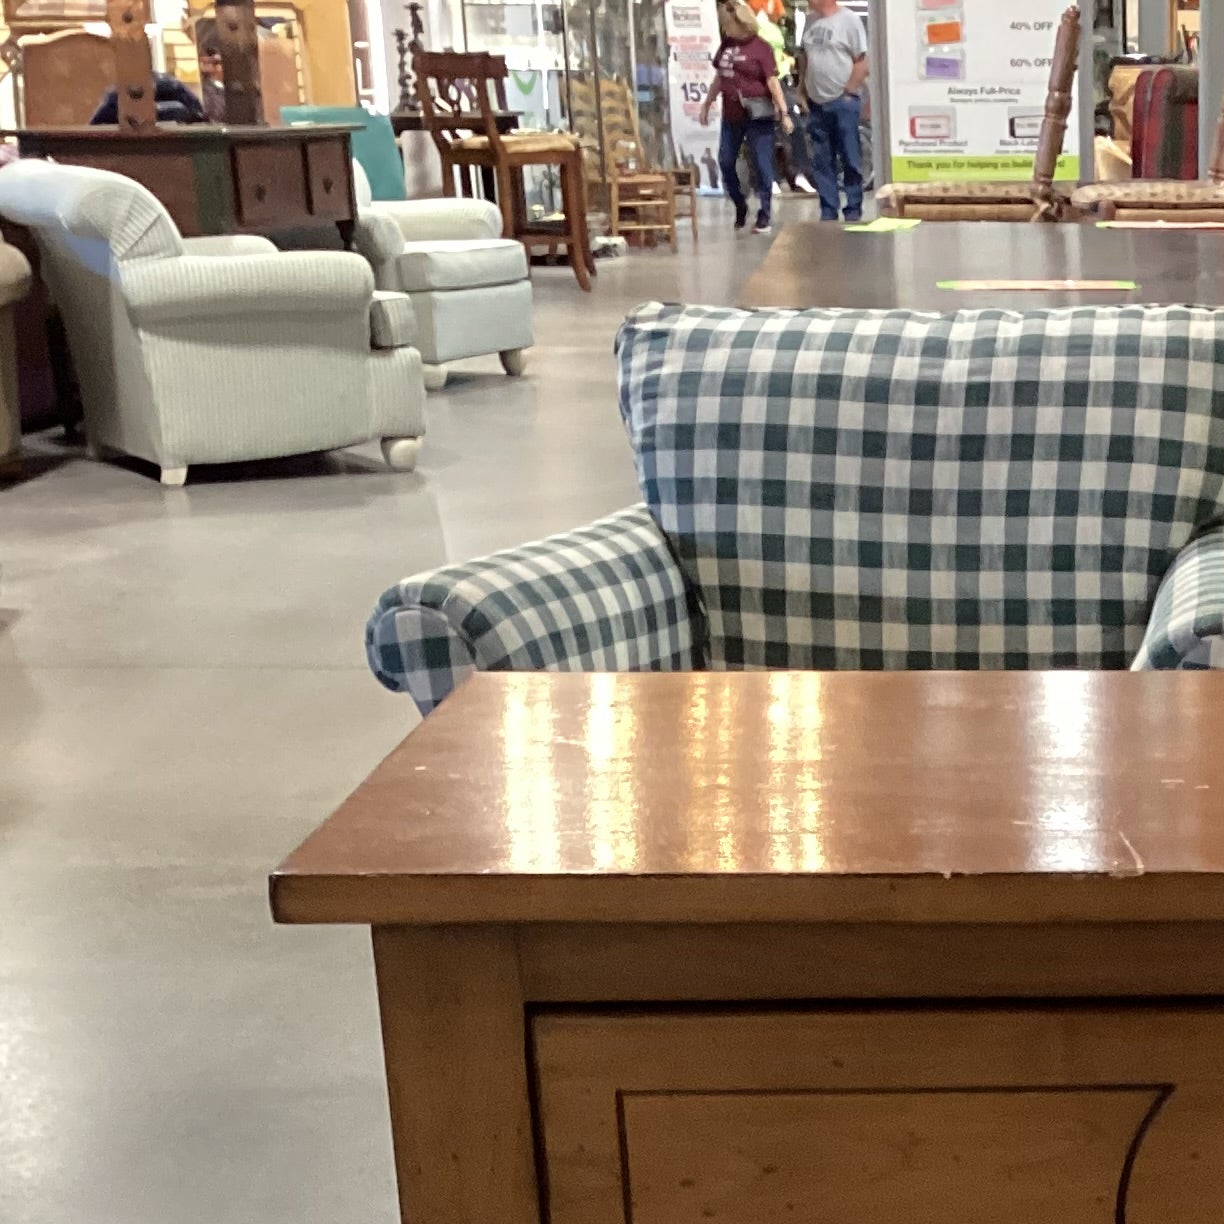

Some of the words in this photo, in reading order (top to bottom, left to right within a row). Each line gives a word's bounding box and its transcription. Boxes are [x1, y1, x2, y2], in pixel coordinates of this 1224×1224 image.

[1010, 22, 1031, 31] 40%
[1034, 22, 1053, 31] OFF
[1010, 58, 1031, 67] 60%
[947, 87, 978, 97] Always
[907, 160, 932, 168] Thank
[936, 161, 950, 169] you
[952, 160, 965, 168] for
[967, 160, 998, 169] helping
